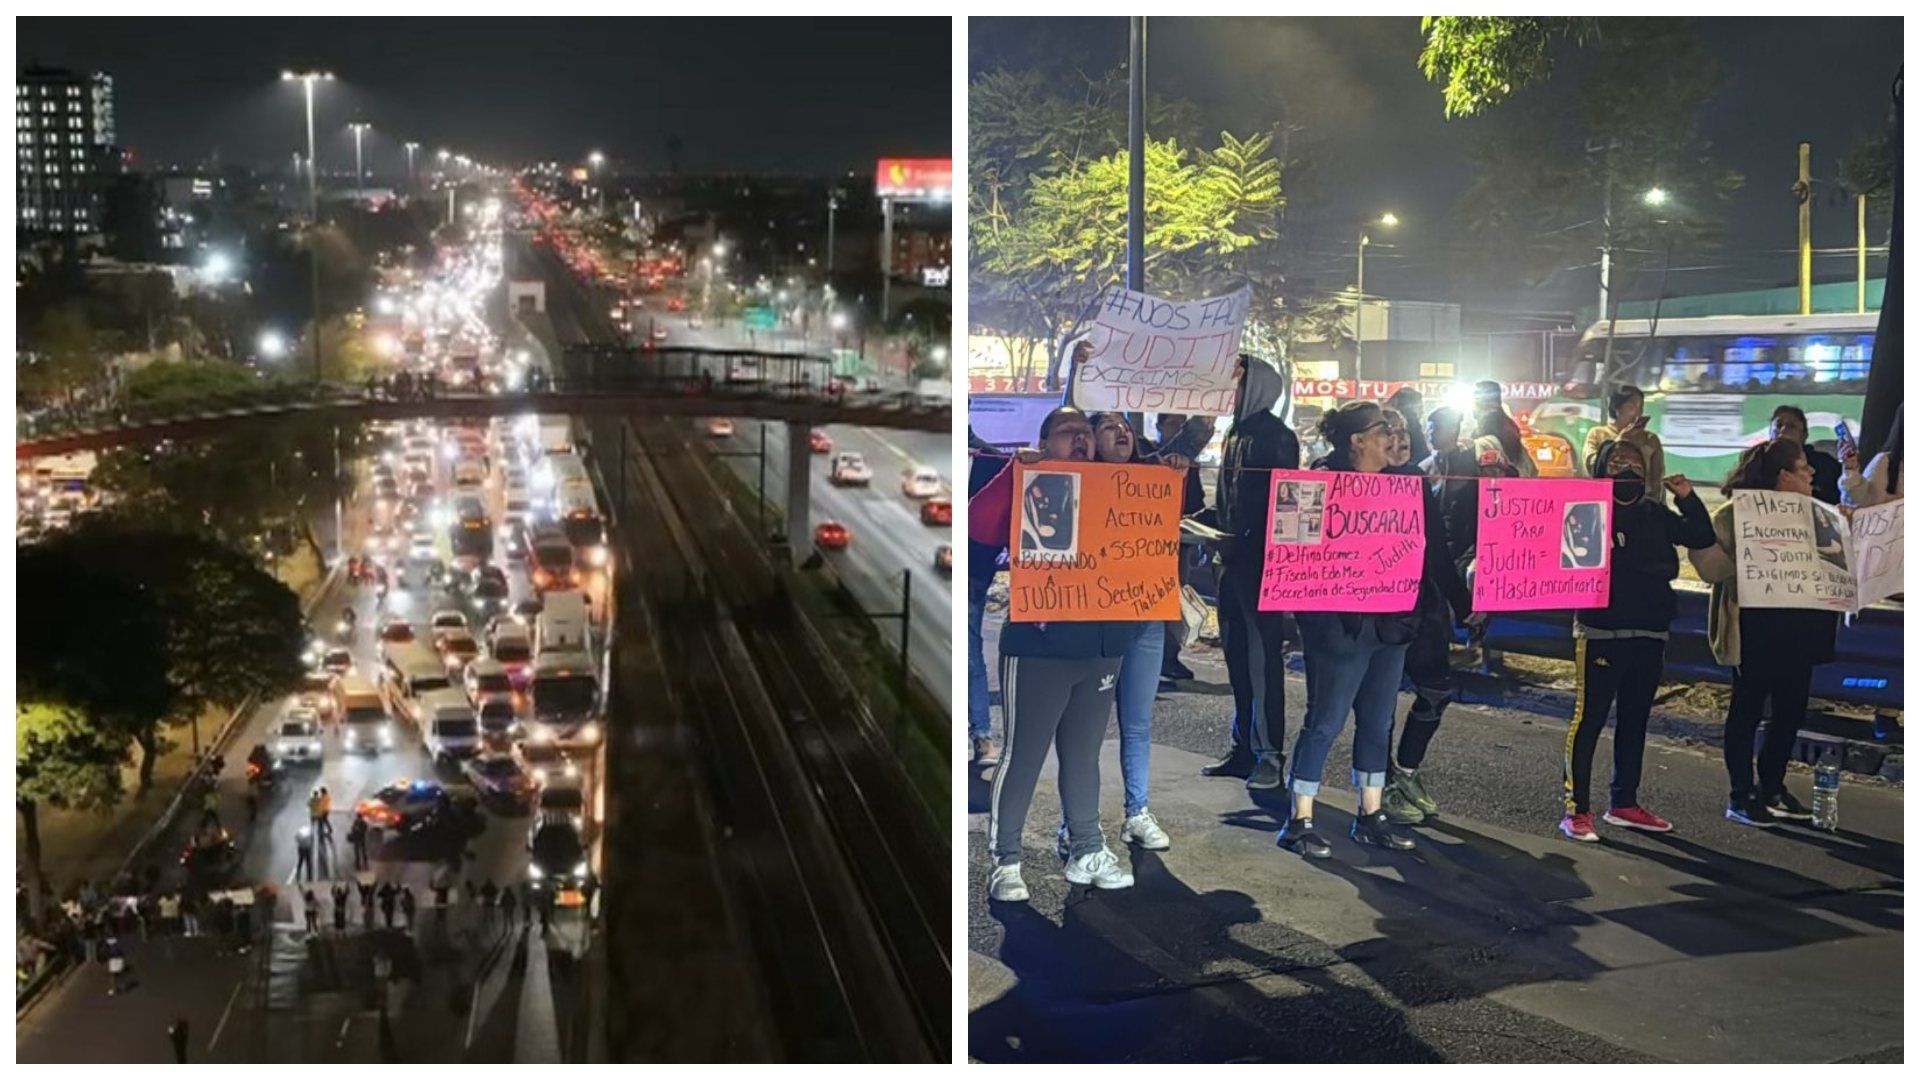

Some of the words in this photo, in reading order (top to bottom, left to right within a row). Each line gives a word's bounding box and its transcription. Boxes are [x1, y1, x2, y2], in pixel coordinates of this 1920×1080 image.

[1106, 290, 1190, 330] #NOS
[1080, 365, 1215, 388] EXIGIMOS
[1360, 381, 1388, 397] TU
[1111, 470, 1171, 499] POLICIA
[1330, 473, 1381, 499] APOYO
[1387, 475, 1420, 497] PARA
[1485, 488, 1554, 518] JUSTICIA
[1105, 507, 1163, 528] ACTIVA
[1326, 503, 1420, 539] BUSCARLA
[1512, 521, 1545, 538] PARA
[1743, 547, 1752, 561] A
[1762, 548, 1813, 563] JUDITH
[1746, 565, 1807, 580] EXIGIMOS
[1018, 583, 1088, 613] JUDITH
[1097, 575, 1144, 609] Sector
[1765, 583, 1774, 594] A
[1787, 583, 1804, 594] LA
